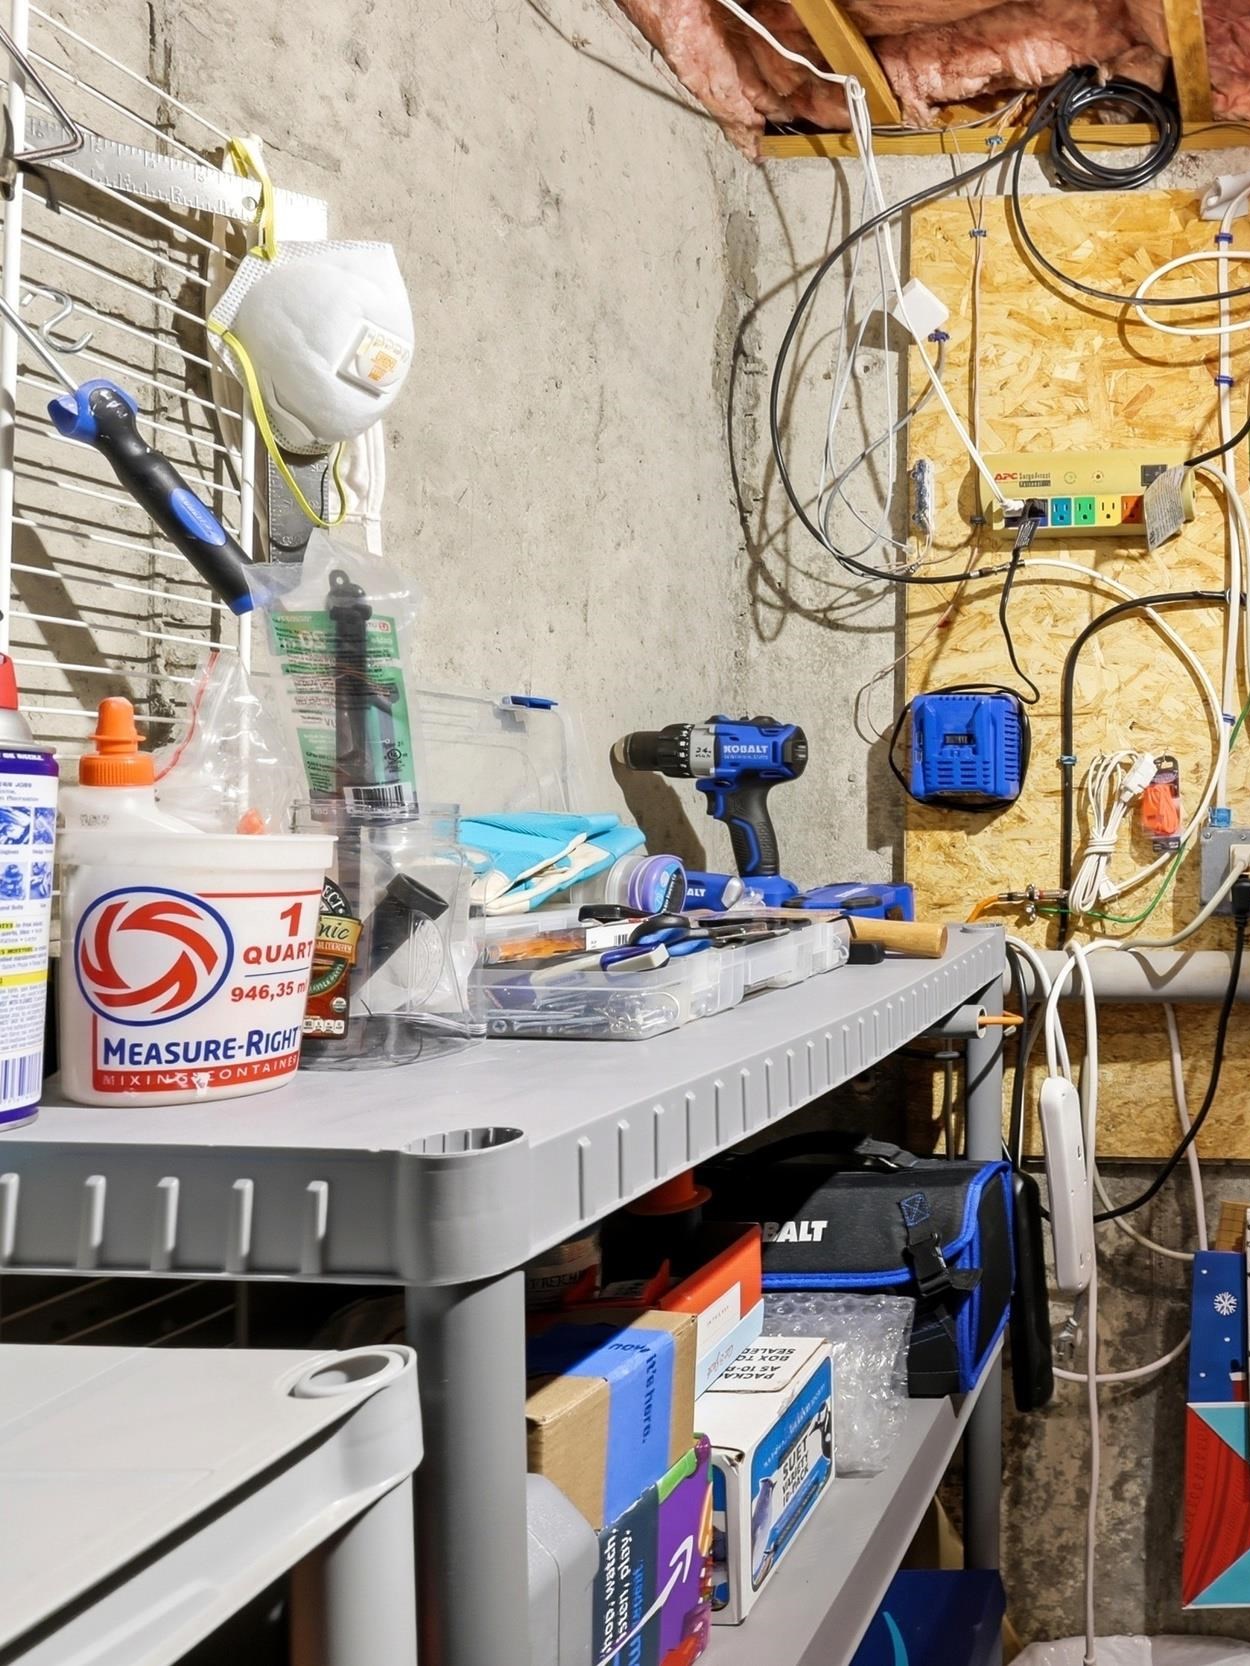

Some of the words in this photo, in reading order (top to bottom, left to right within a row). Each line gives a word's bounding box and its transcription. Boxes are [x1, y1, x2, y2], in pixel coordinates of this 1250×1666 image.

[994, 472, 1018, 481] APC
[723, 744, 769, 754] KOBALT
[686, 887, 707, 897] ALT
[280, 901, 303, 937] 1
[243, 940, 313, 965] QUART
[231, 981, 295, 1003] 946,35
[102, 1071, 189, 1088] MIXING
[762, 1220, 828, 1242] BALT
[724, 1372, 775, 1380] PACKA
[782, 1434, 808, 1481] SUET
[604, 1528, 617, 1600] watch,
[618, 1529, 633, 1580] play,
